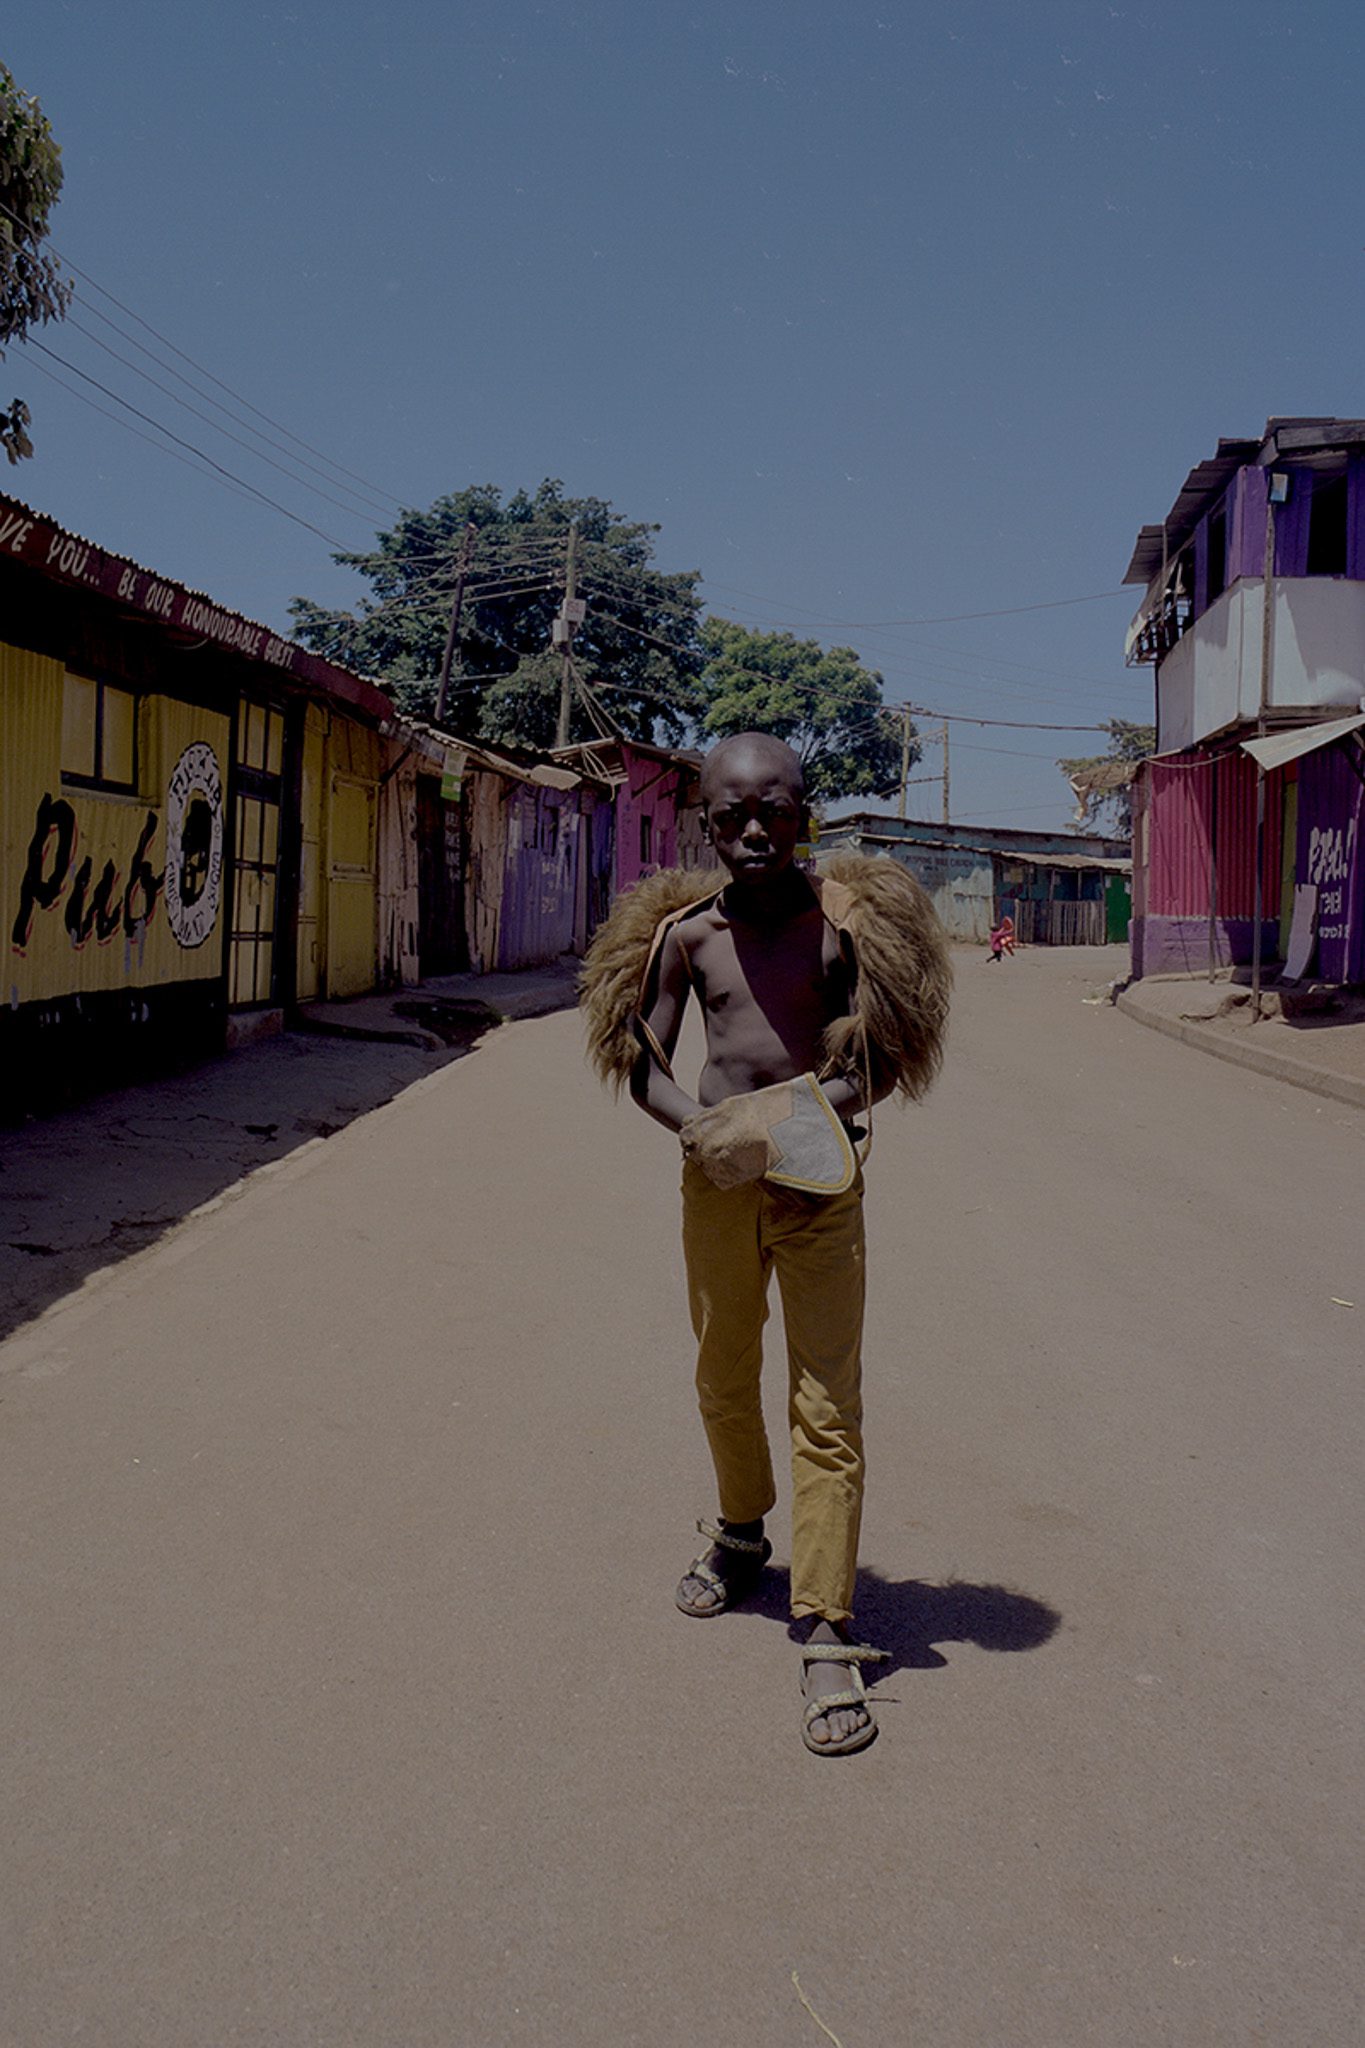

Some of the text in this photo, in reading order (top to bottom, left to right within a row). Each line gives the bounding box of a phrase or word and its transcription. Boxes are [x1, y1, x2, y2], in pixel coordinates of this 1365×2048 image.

[0, 508, 34, 553] VE
[45, 532, 100, 587] YOU...
[116, 566, 139, 601] BE
[144, 581, 175, 617] OUR
[181, 597, 264, 656] HONOURABLE
[12, 791, 166, 952] Pub
